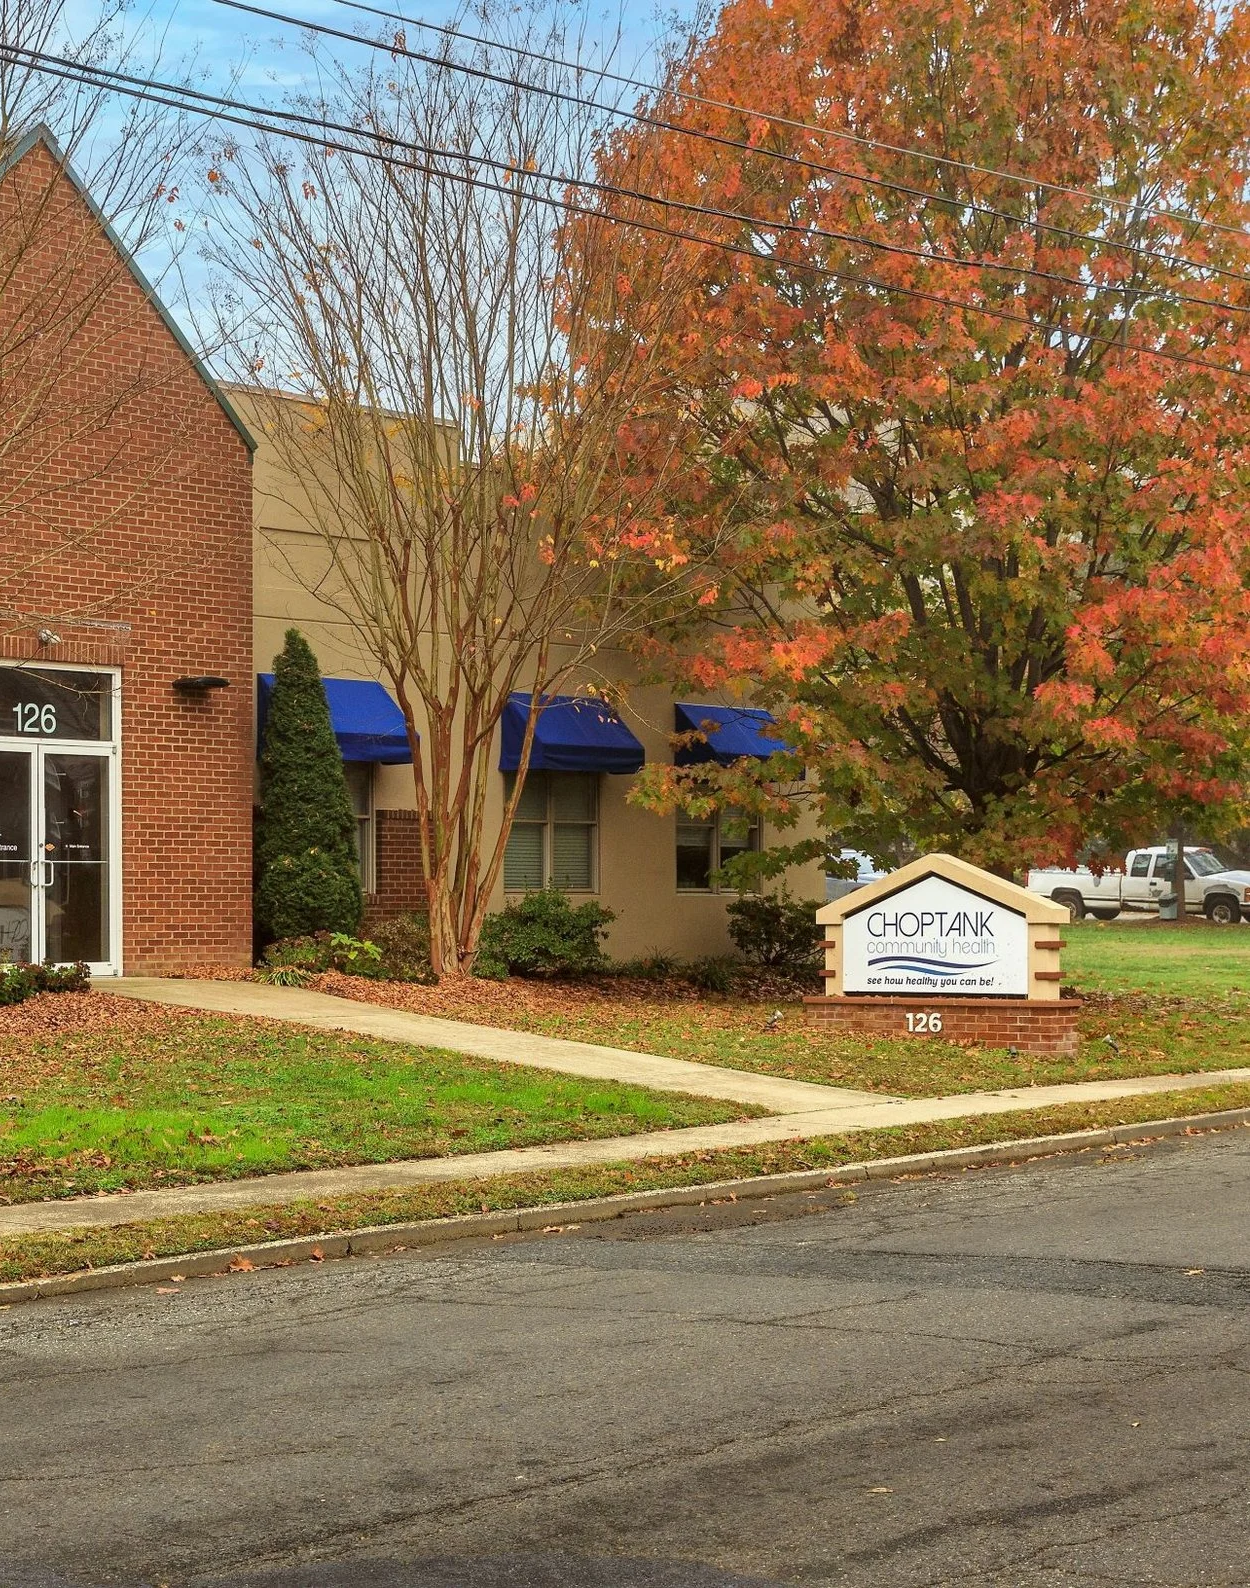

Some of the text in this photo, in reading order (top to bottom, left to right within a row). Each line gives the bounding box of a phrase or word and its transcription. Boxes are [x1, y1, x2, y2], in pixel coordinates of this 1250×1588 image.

[13, 702, 57, 734] 126
[867, 911, 994, 937] CHOPTANK
[867, 937, 995, 958] community health
[867, 976, 994, 988] see how healthy you can be!
[905, 1012, 943, 1033] 126
